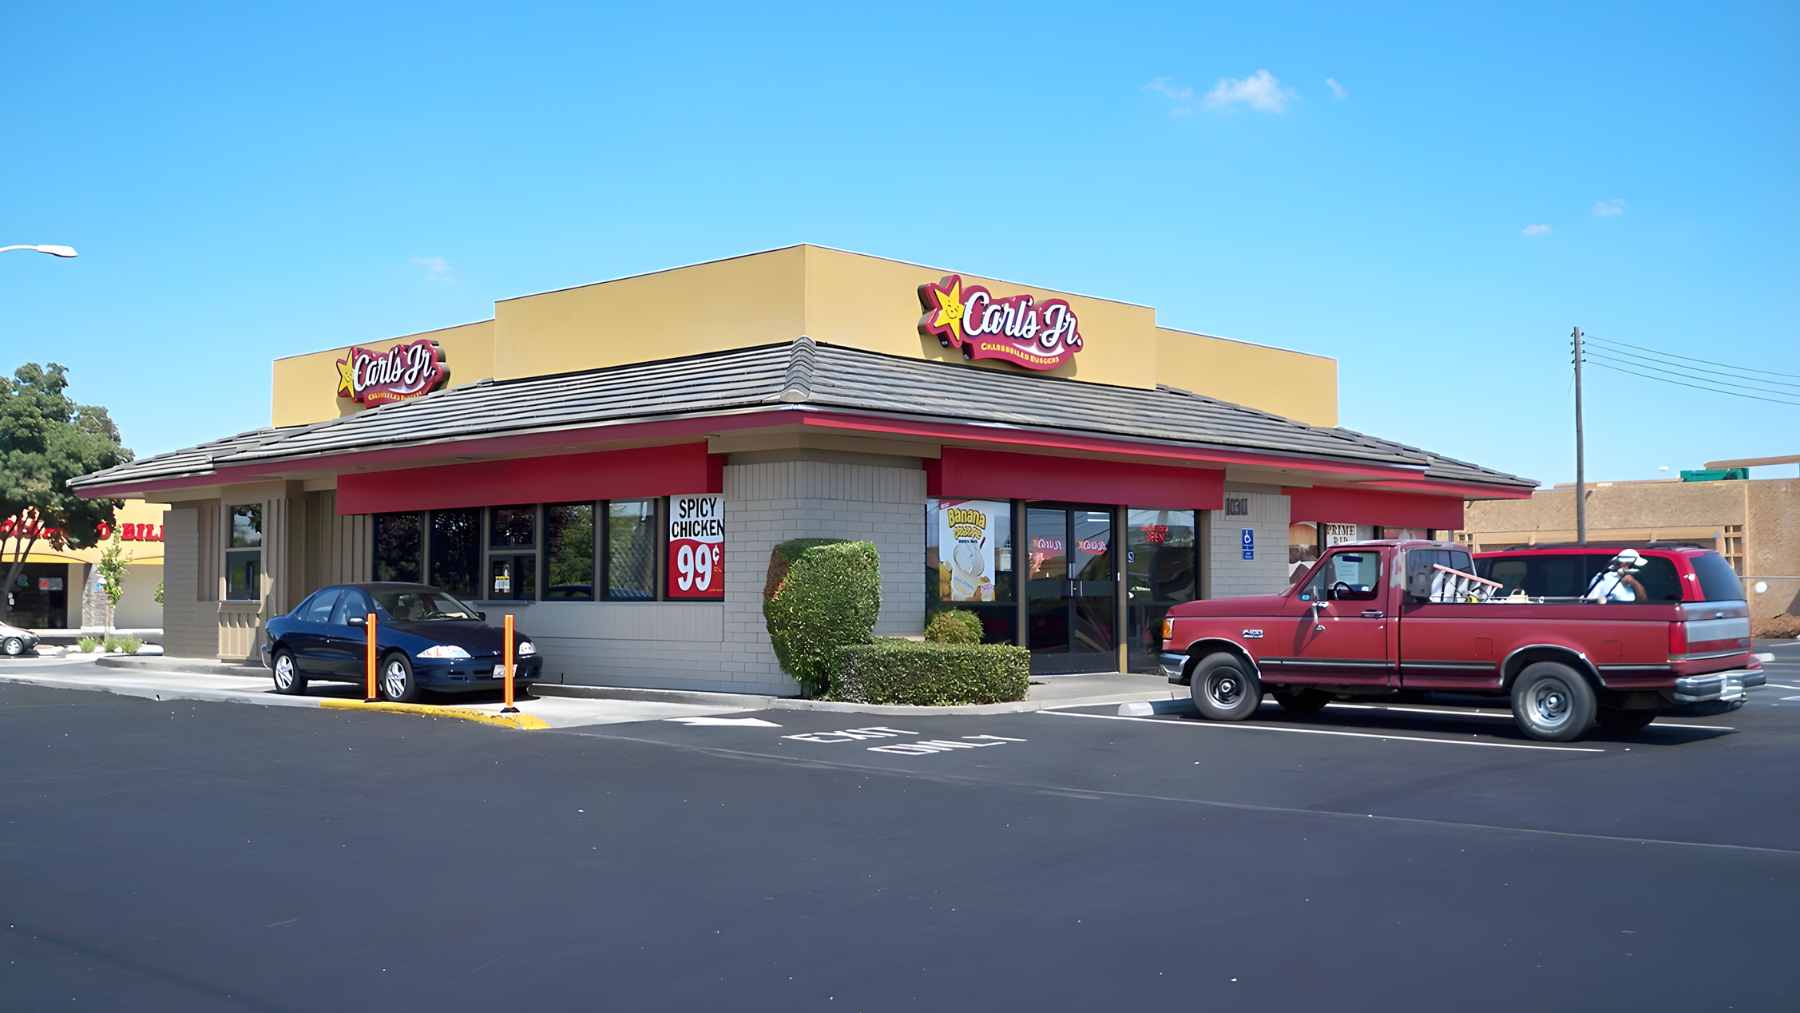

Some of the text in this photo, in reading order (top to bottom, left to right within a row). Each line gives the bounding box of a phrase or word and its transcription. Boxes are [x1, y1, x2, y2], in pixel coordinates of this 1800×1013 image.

[963, 291, 1082, 348] Carl's Jr.
[353, 344, 436, 392] Carl's Jr.
[679, 497, 718, 518] SPICY
[946, 507, 986, 529] Banana
[671, 520, 725, 538] CHICKEN
[781, 727, 919, 743] EXIT
[867, 735, 1027, 756] ONLY
